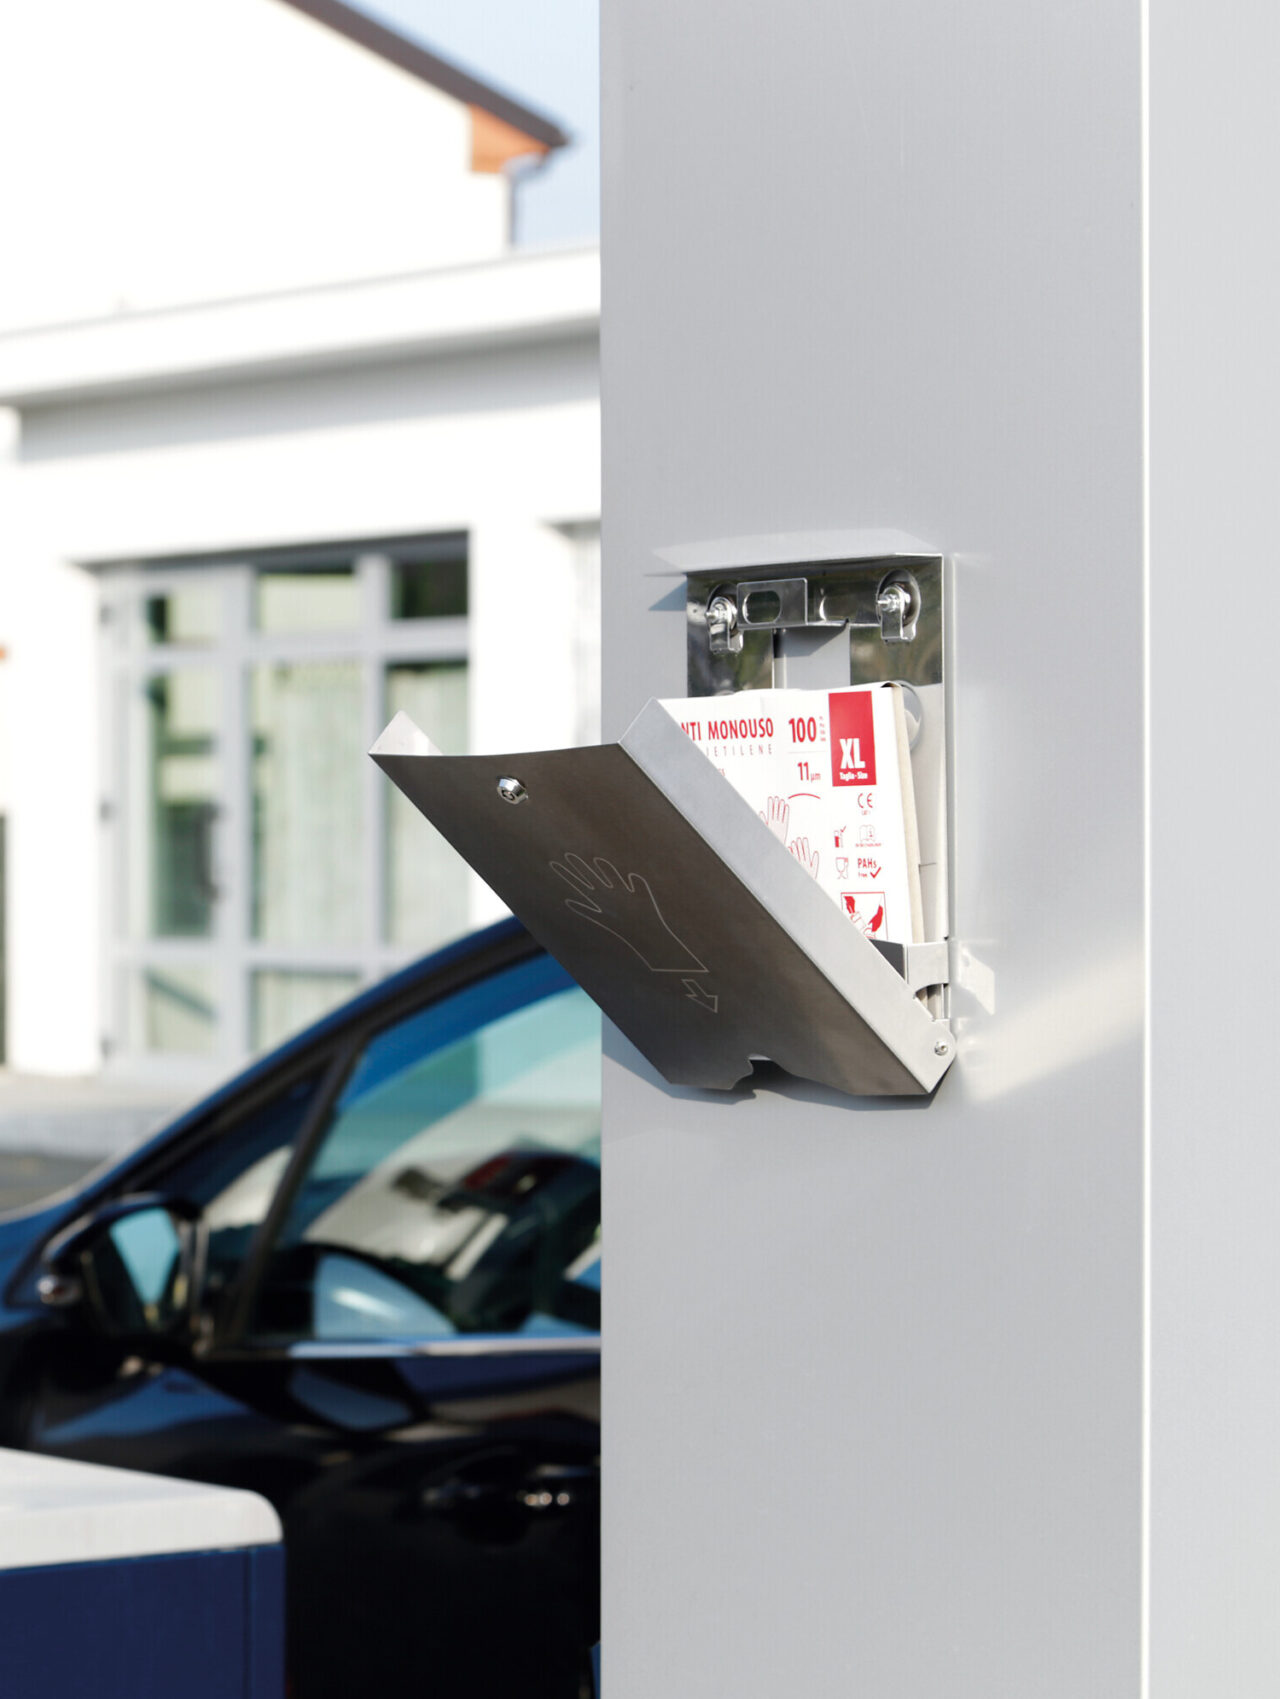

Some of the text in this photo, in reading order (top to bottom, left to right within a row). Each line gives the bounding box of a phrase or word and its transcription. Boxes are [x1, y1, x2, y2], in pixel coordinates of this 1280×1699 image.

[707, 717, 774, 741] MONOUSO
[788, 716, 817, 743] 100
[839, 737, 866, 770] XL
[797, 761, 809, 781] 11
